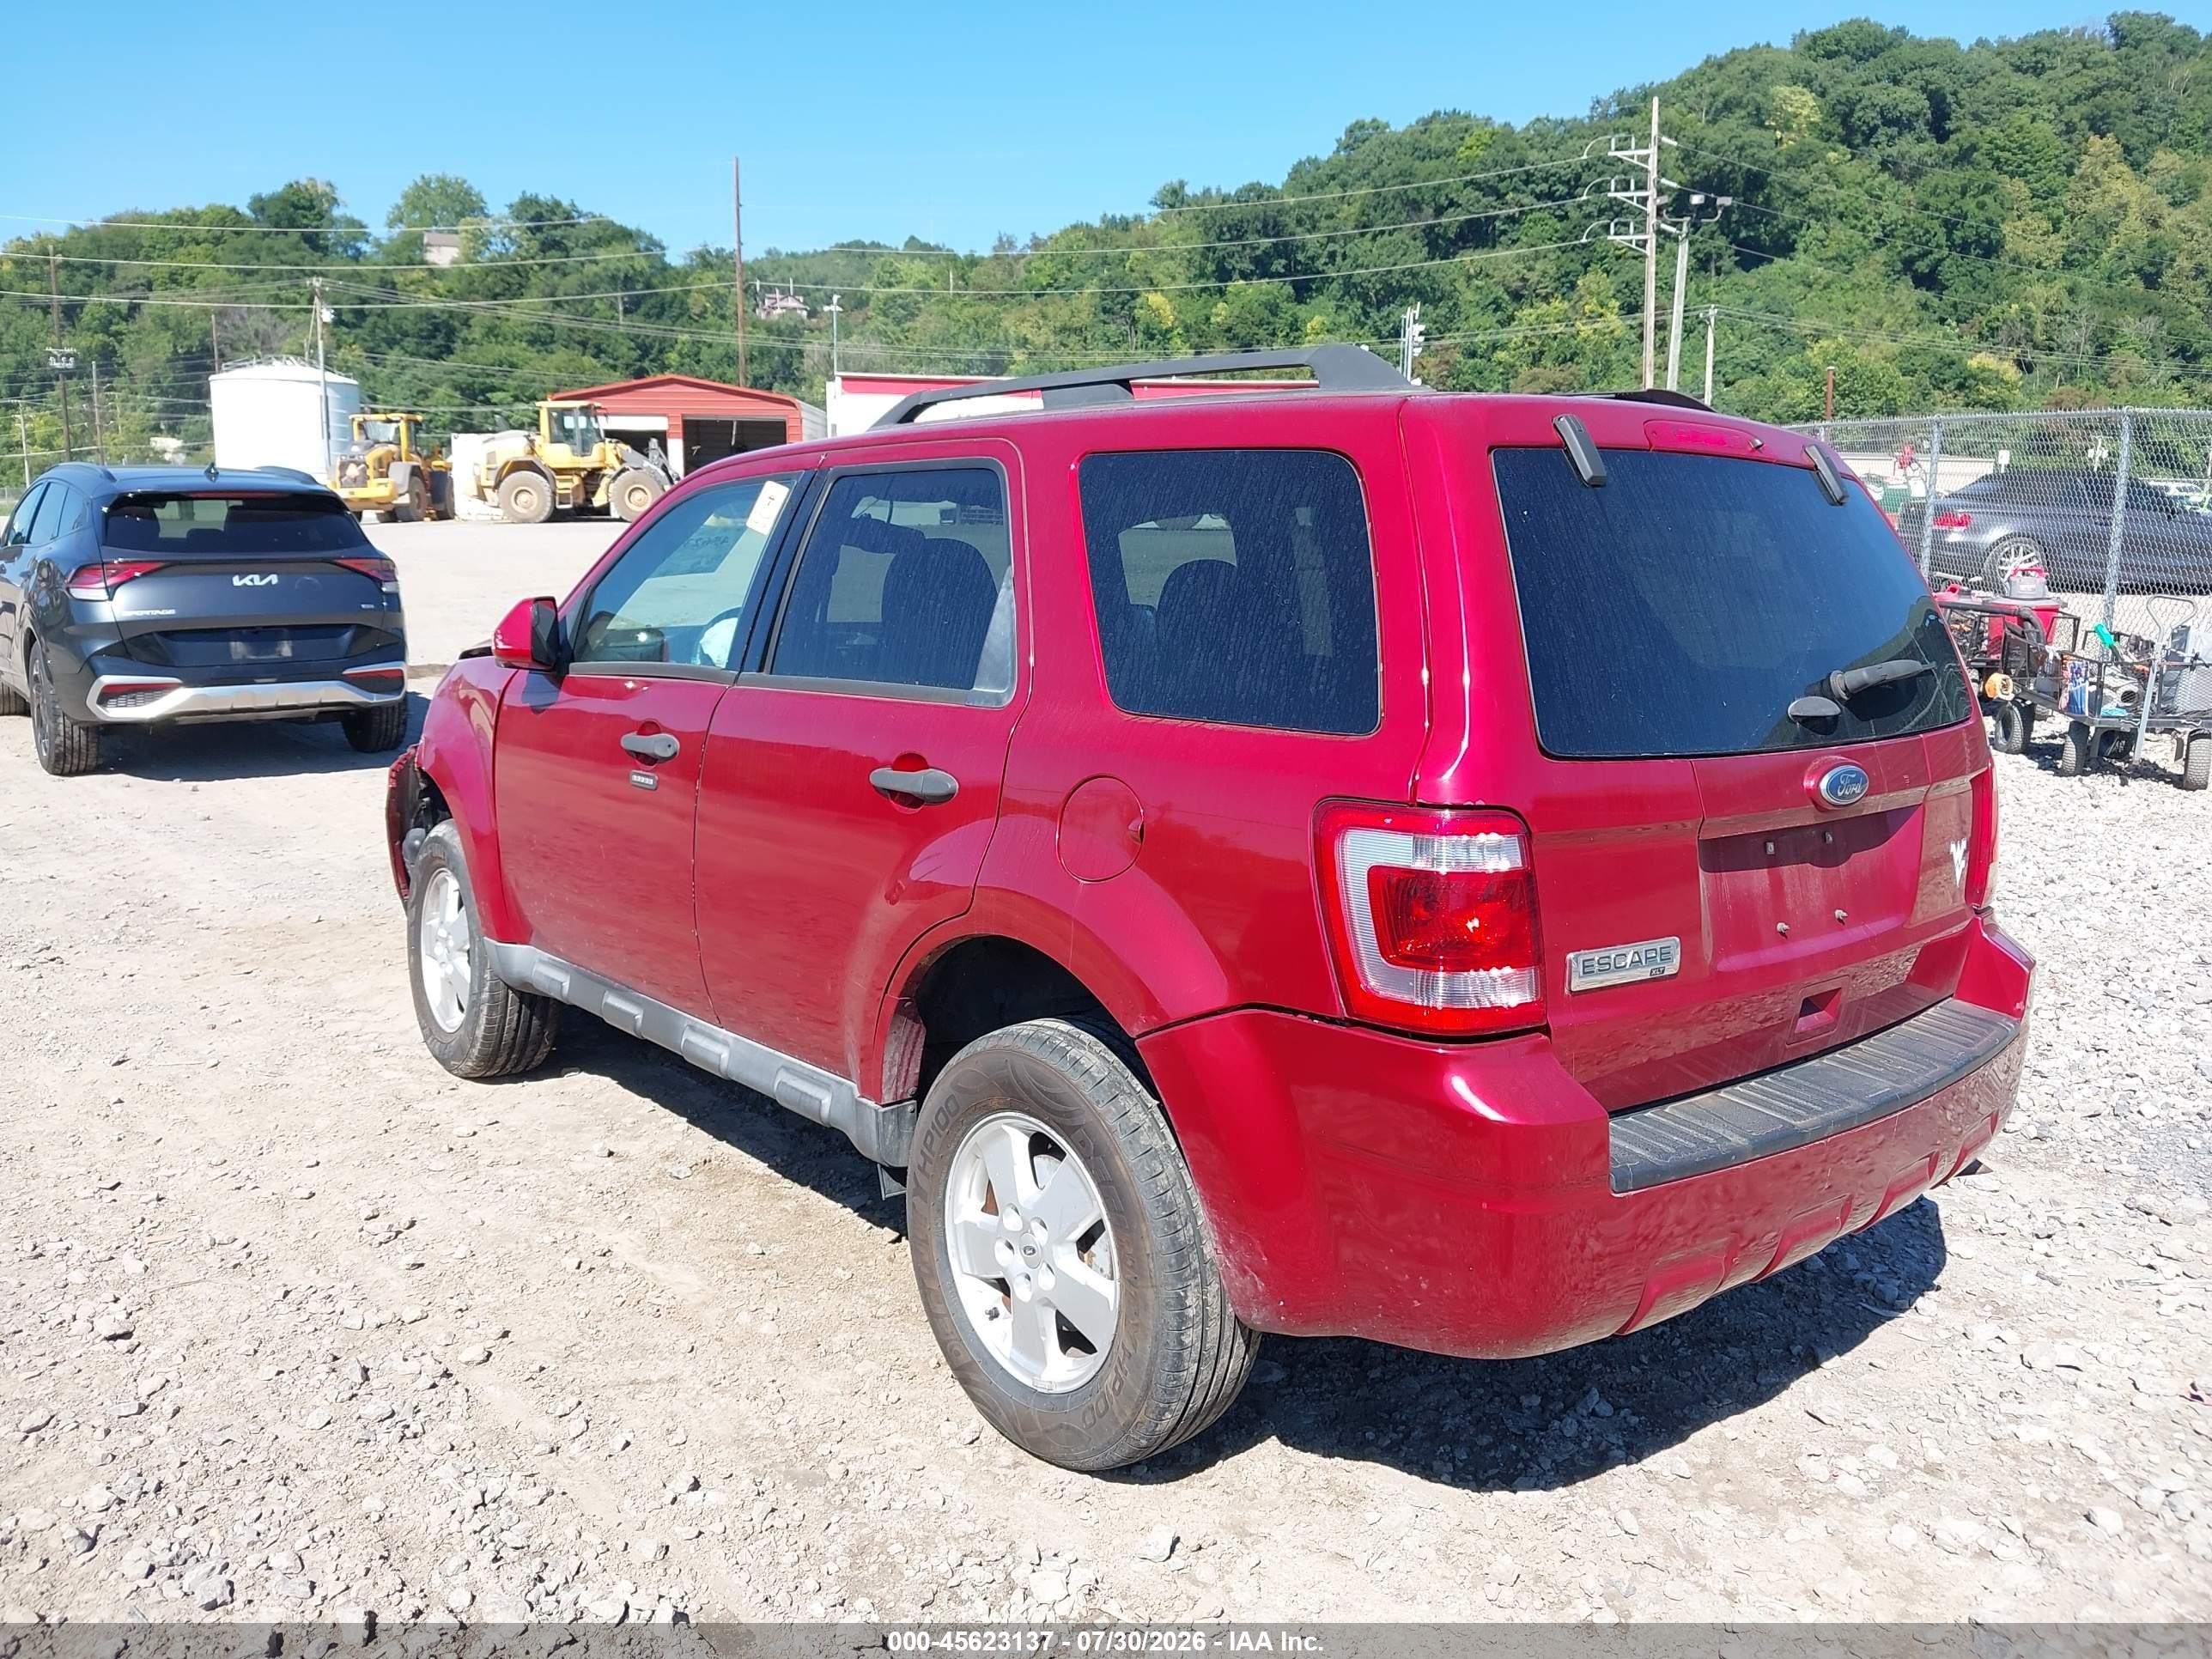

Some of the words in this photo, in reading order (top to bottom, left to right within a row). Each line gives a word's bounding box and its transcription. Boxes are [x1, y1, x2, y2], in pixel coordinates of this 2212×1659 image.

[1837, 772, 1865, 797] Ford
[1582, 945, 1673, 976] ESCAPE
[1650, 967, 1665, 976] XLT
[917, 1093, 961, 1177] HP100
[1081, 1341, 1133, 1430] HP100
